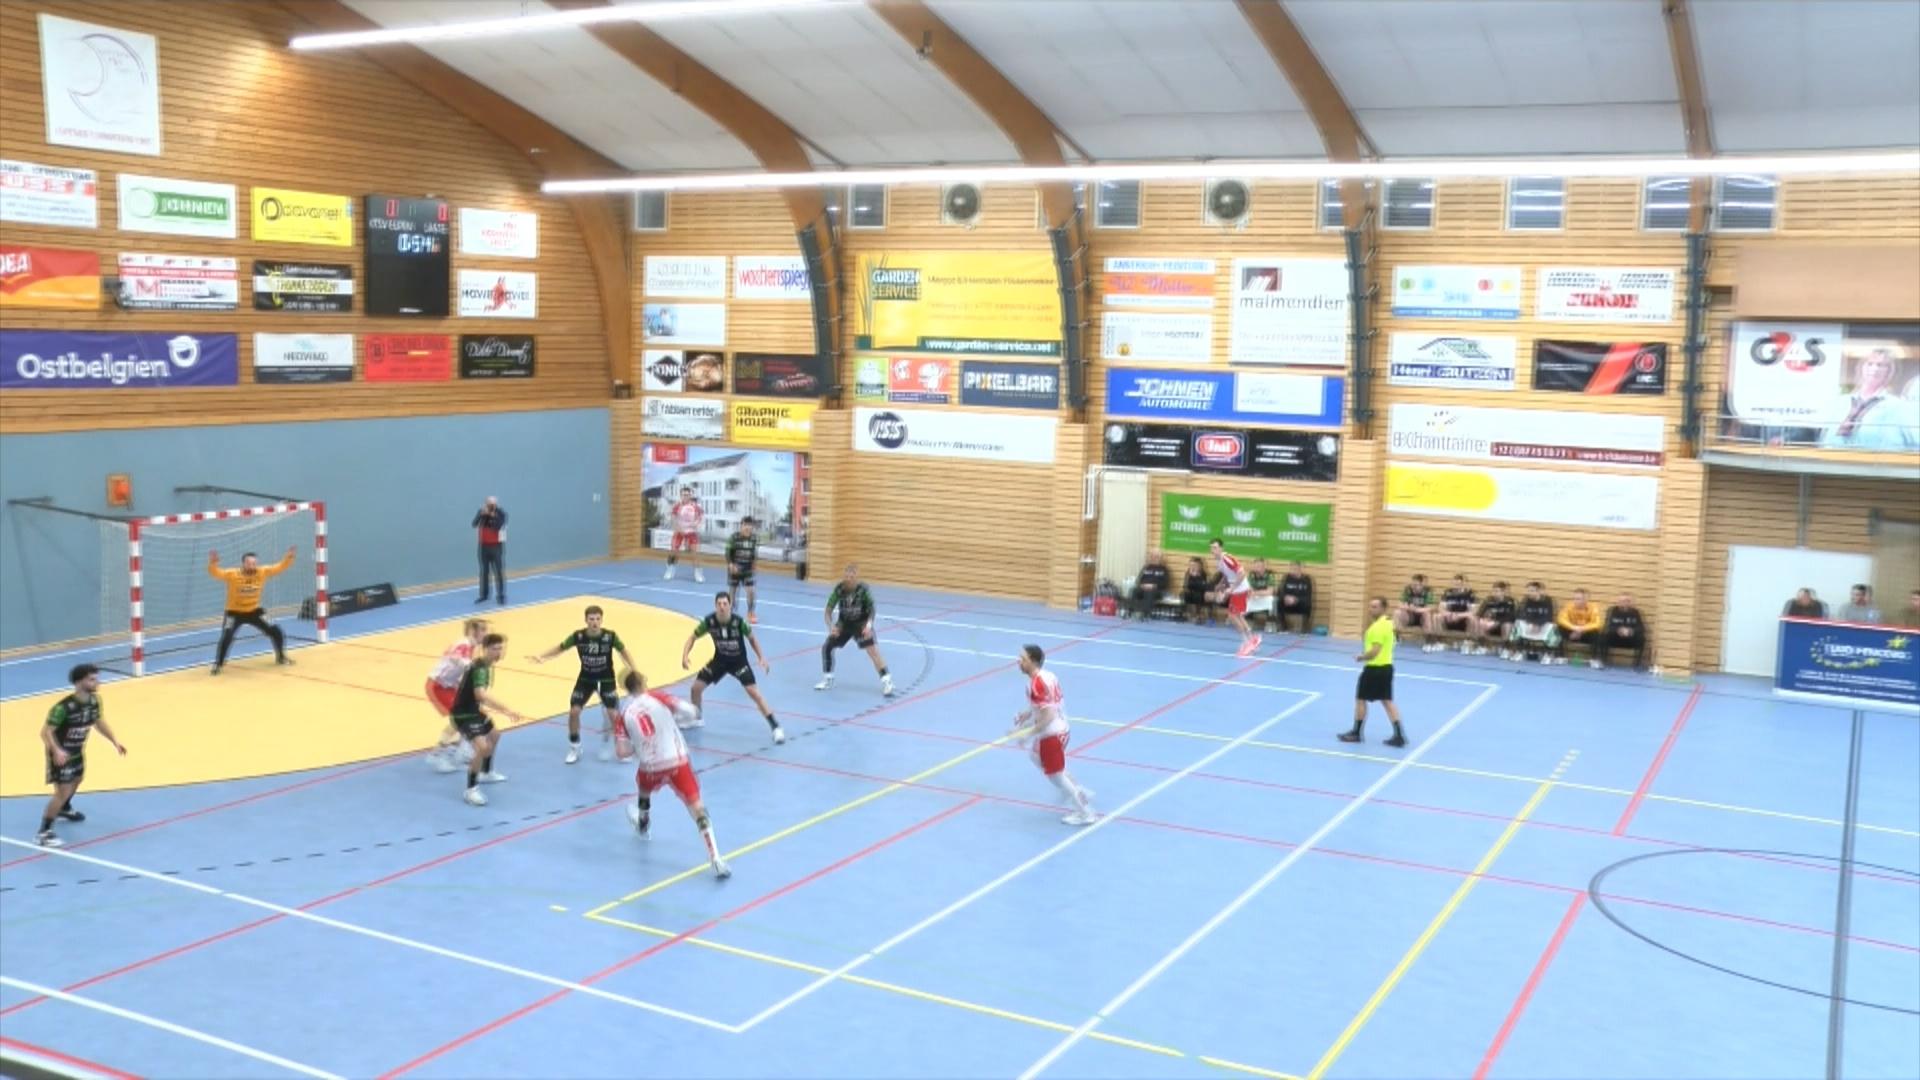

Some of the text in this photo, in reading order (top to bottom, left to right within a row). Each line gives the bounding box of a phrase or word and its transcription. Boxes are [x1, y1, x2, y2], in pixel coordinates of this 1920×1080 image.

[872, 269, 920, 283] GARDEN
[872, 286, 920, 299] SERVICE
[1240, 294, 1345, 311] malmendier
[17, 352, 170, 385] Ostbelgien
[1133, 378, 1219, 397] JOHNEN
